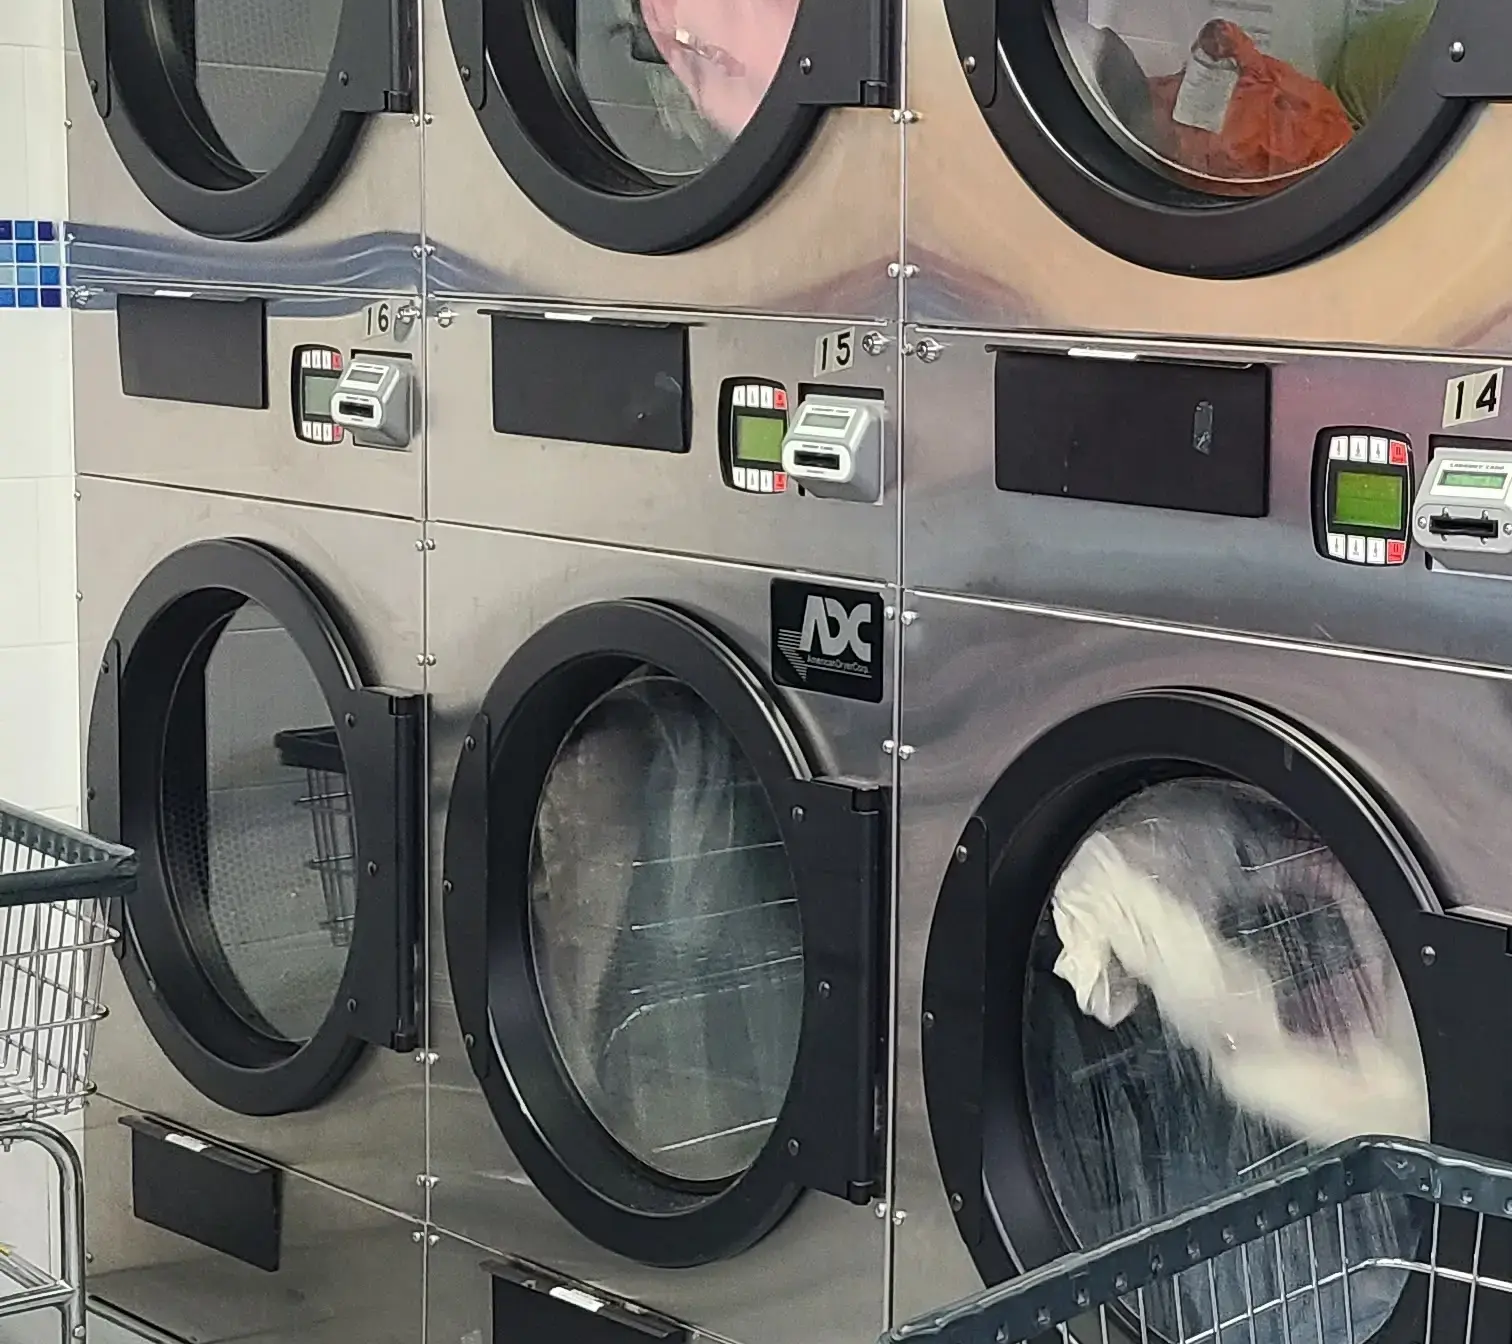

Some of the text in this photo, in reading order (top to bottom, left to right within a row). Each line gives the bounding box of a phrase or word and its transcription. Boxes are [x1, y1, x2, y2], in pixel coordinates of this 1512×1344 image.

[366, 303, 389, 335] 16
[821, 331, 850, 370] 15
[1455, 373, 1498, 420] 14
[799, 594, 871, 662] ADC
